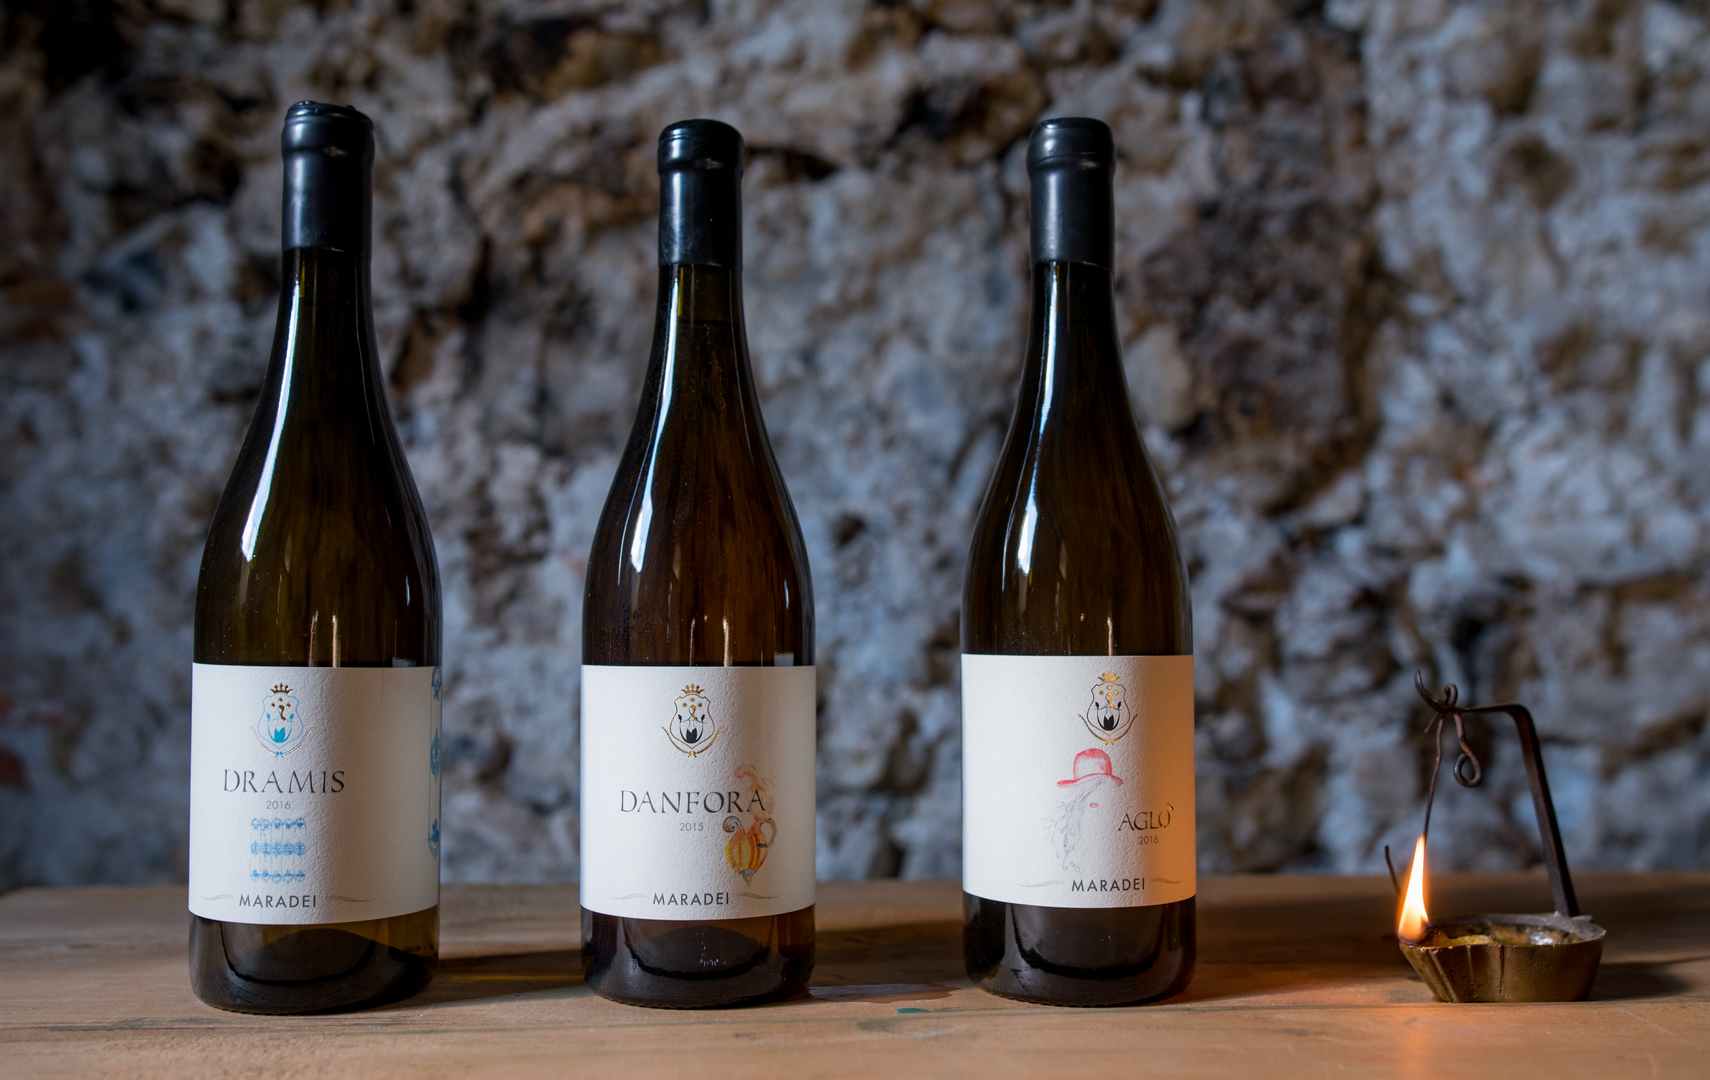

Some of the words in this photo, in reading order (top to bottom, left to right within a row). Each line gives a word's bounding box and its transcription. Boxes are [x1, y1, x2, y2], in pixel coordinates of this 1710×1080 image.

[224, 768, 345, 794] DRAMIS
[266, 800, 291, 810] 2016
[620, 789, 766, 814] DANFORA
[679, 822, 704, 832] 2015
[1071, 877, 1145, 892] MARADEI
[239, 894, 317, 908] MARADEI
[652, 891, 730, 906] MARADEI
